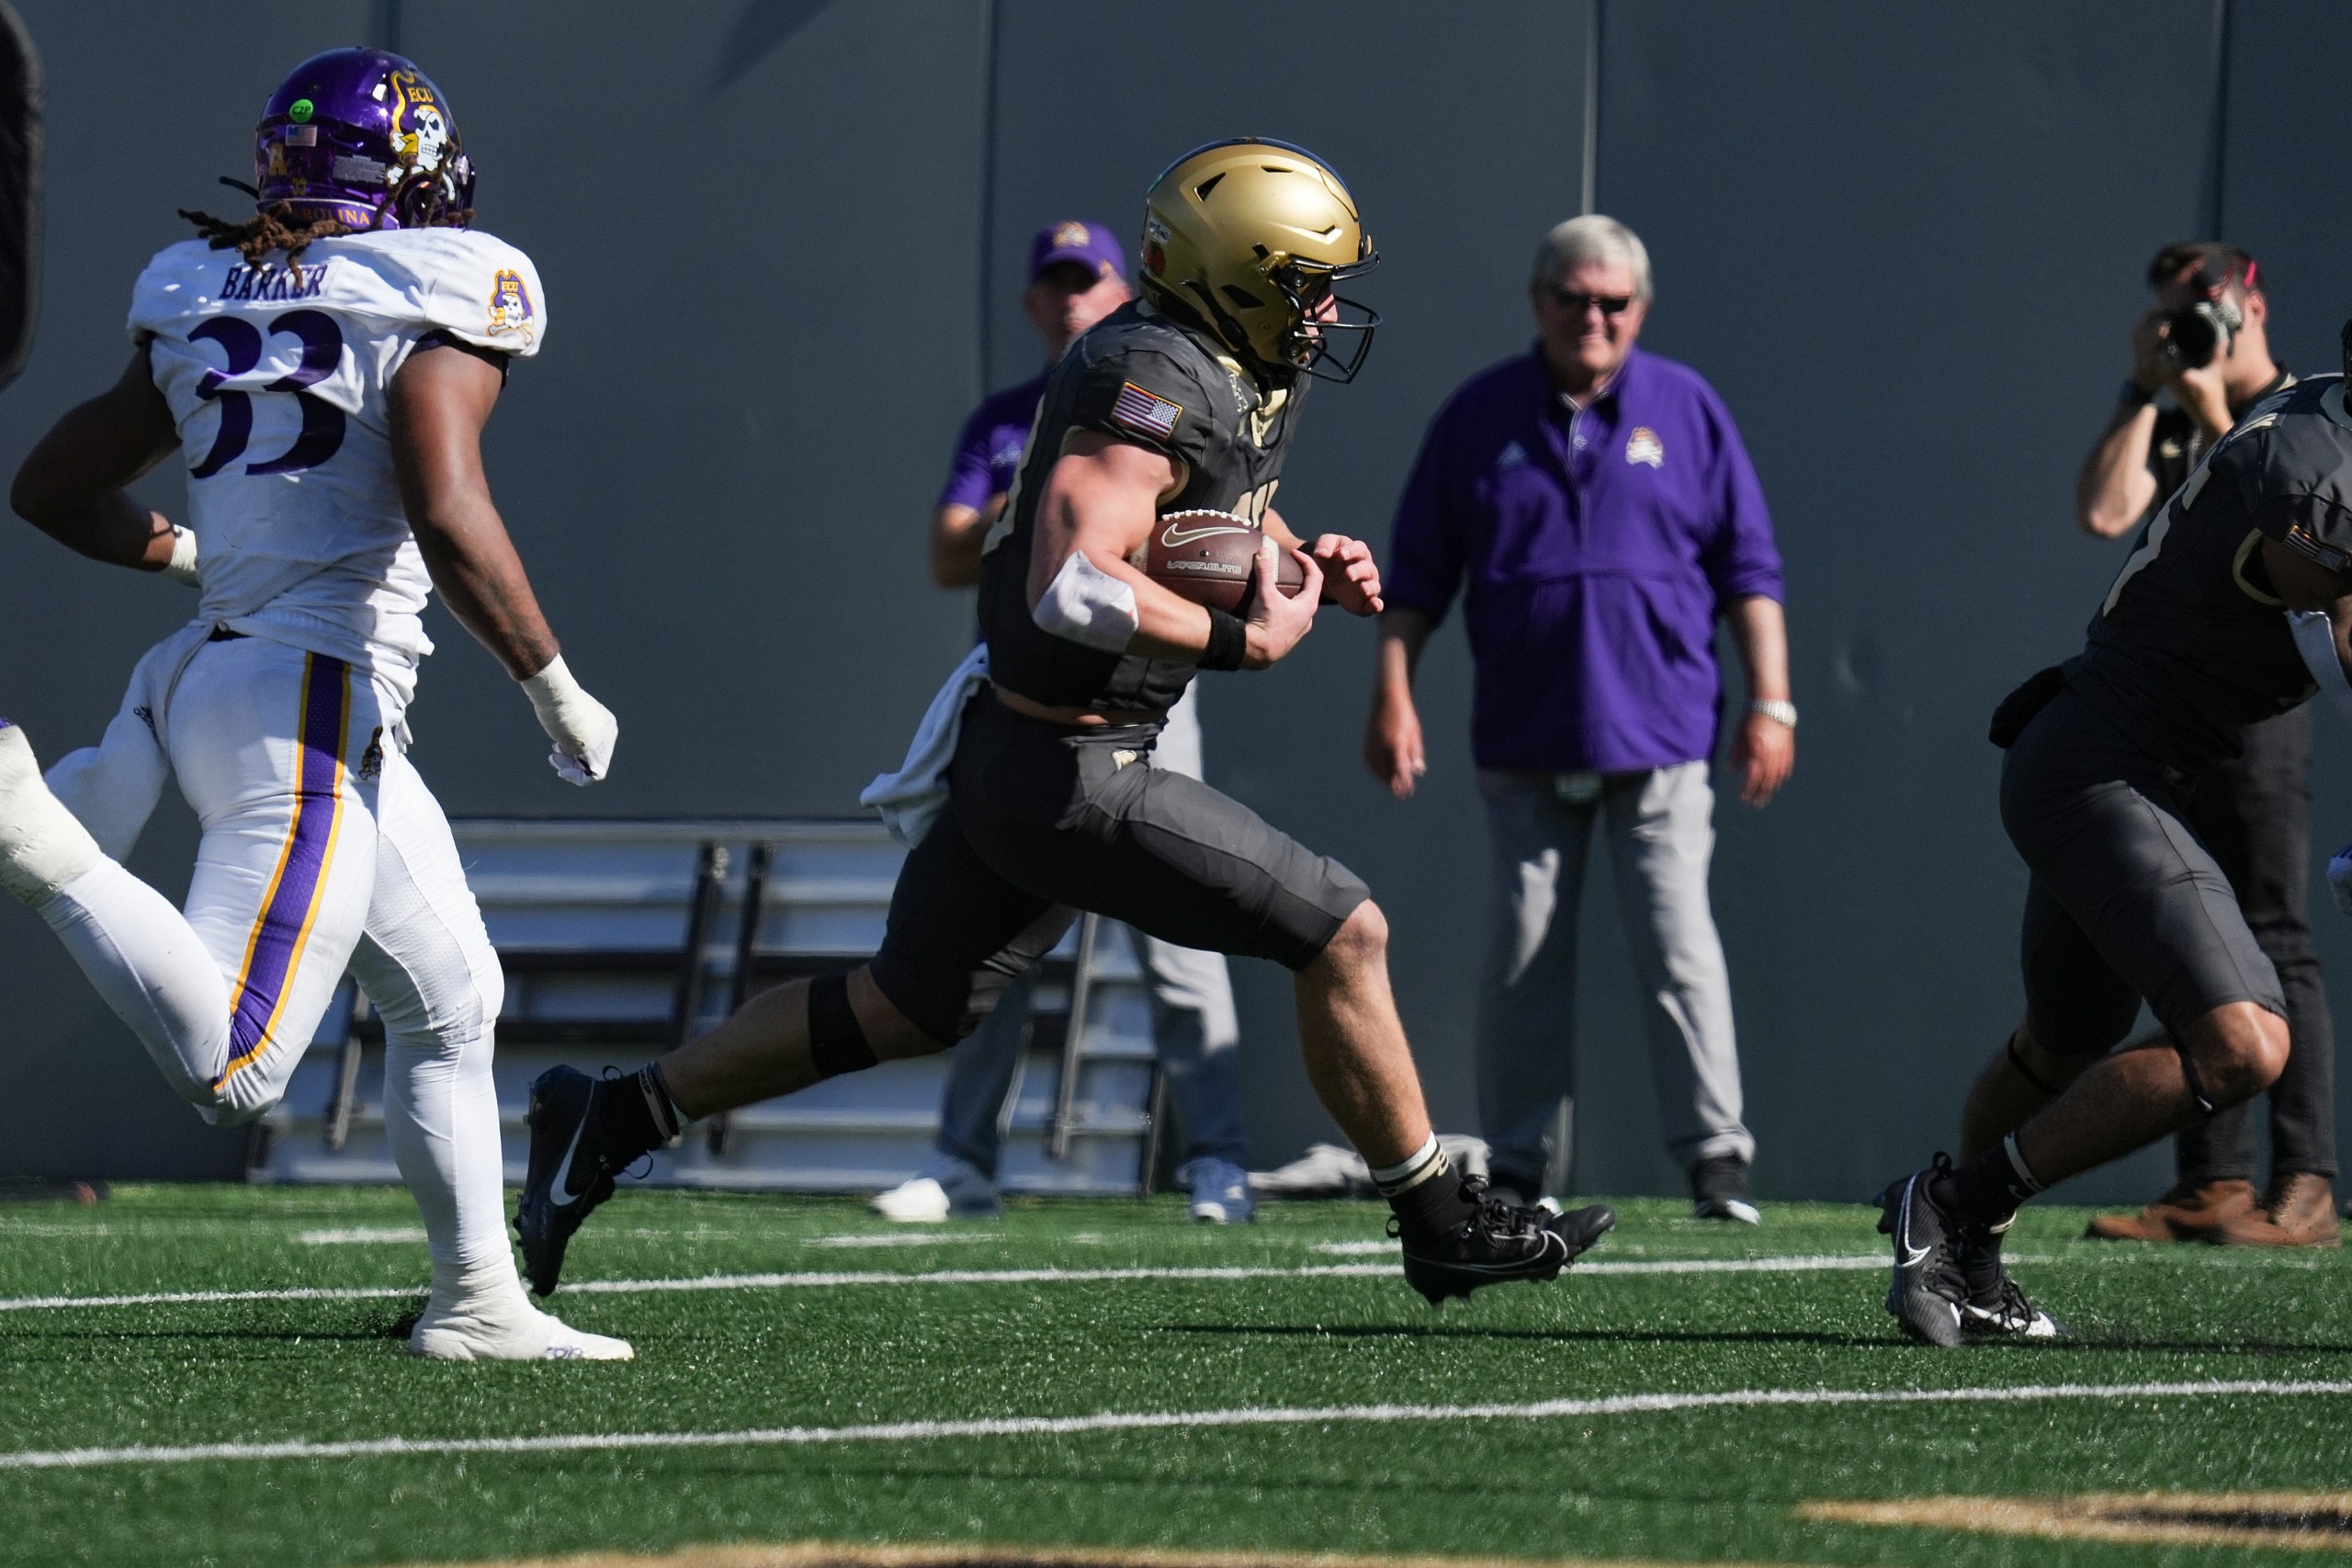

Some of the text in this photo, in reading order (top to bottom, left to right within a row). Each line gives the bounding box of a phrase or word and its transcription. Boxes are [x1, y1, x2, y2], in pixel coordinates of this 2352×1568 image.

[407, 87, 434, 103] ECU
[291, 106, 311, 115] C2P
[219, 265, 328, 300] BARKER
[501, 280, 519, 292] ECU
[187, 310, 346, 479] 33
